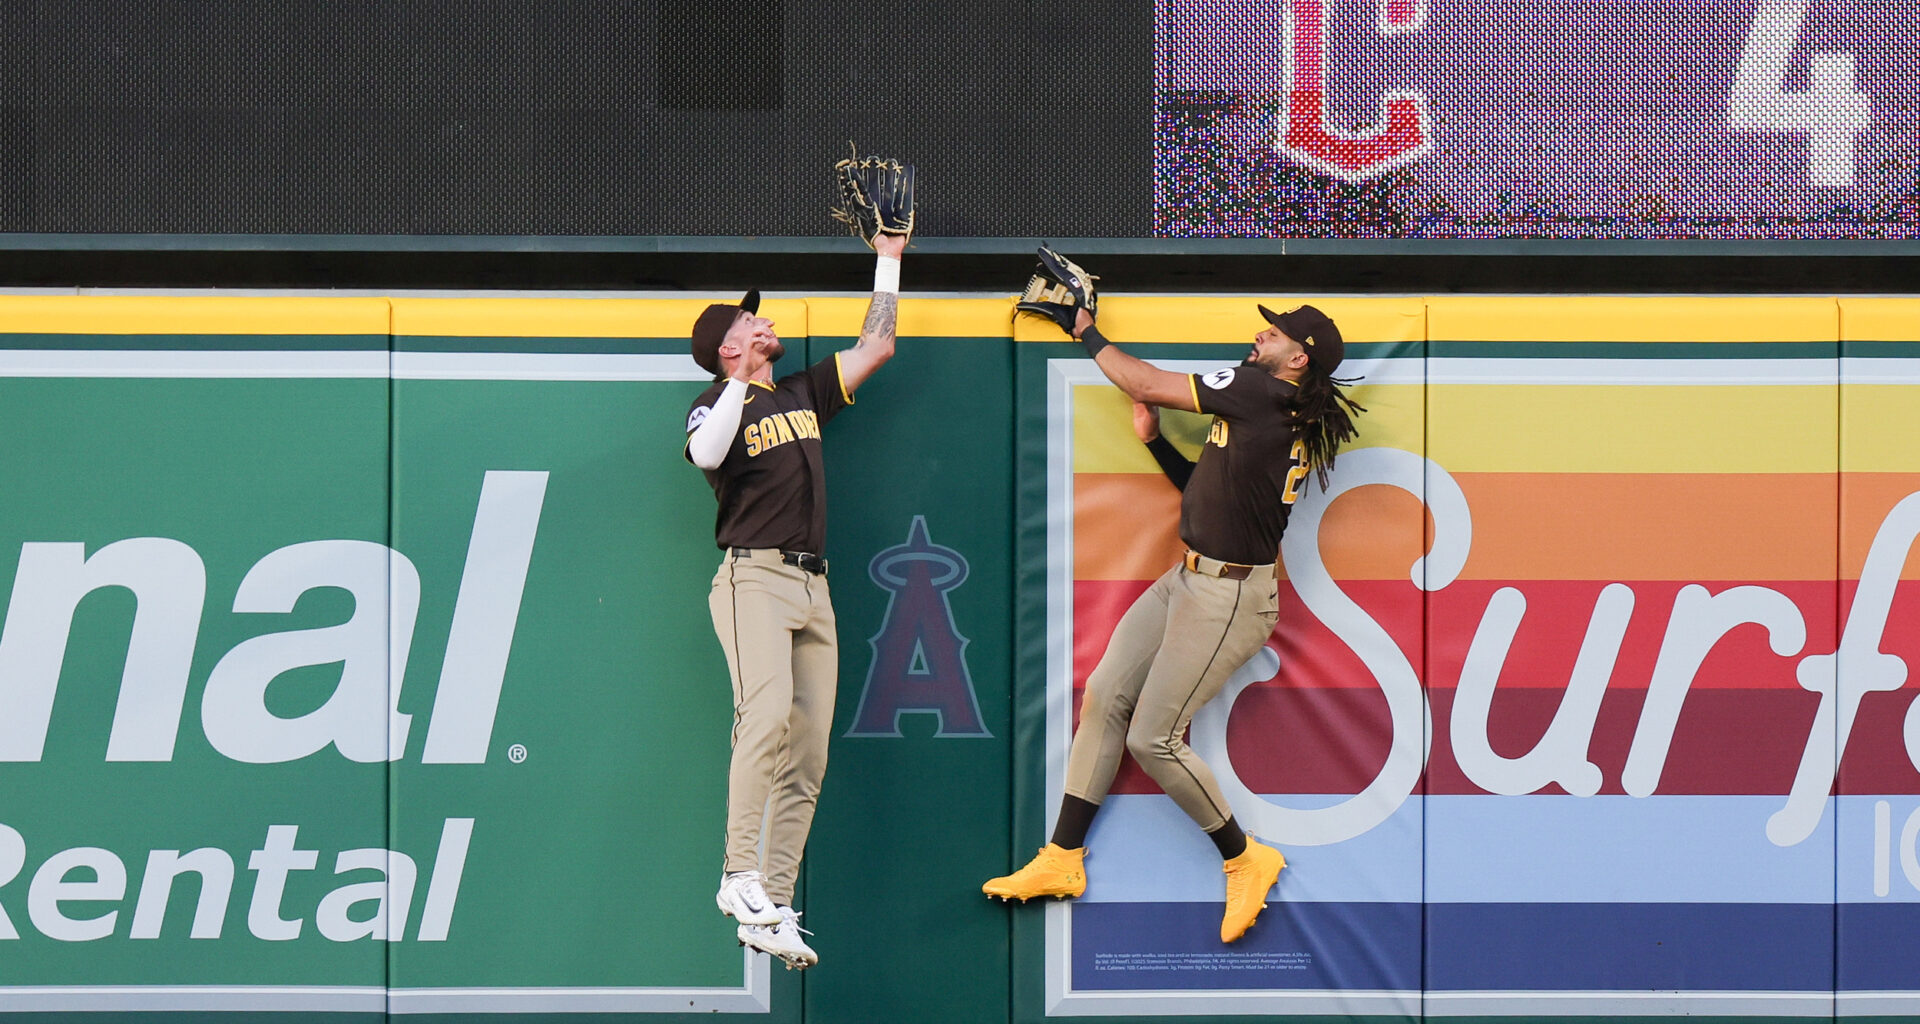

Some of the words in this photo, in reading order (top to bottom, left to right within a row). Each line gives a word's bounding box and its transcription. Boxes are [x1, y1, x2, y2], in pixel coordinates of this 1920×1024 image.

[1728, 0, 1872, 188] 4
[743, 413, 795, 458] SAN
[842, 514, 995, 738] A
[1189, 446, 1920, 847] Surf
